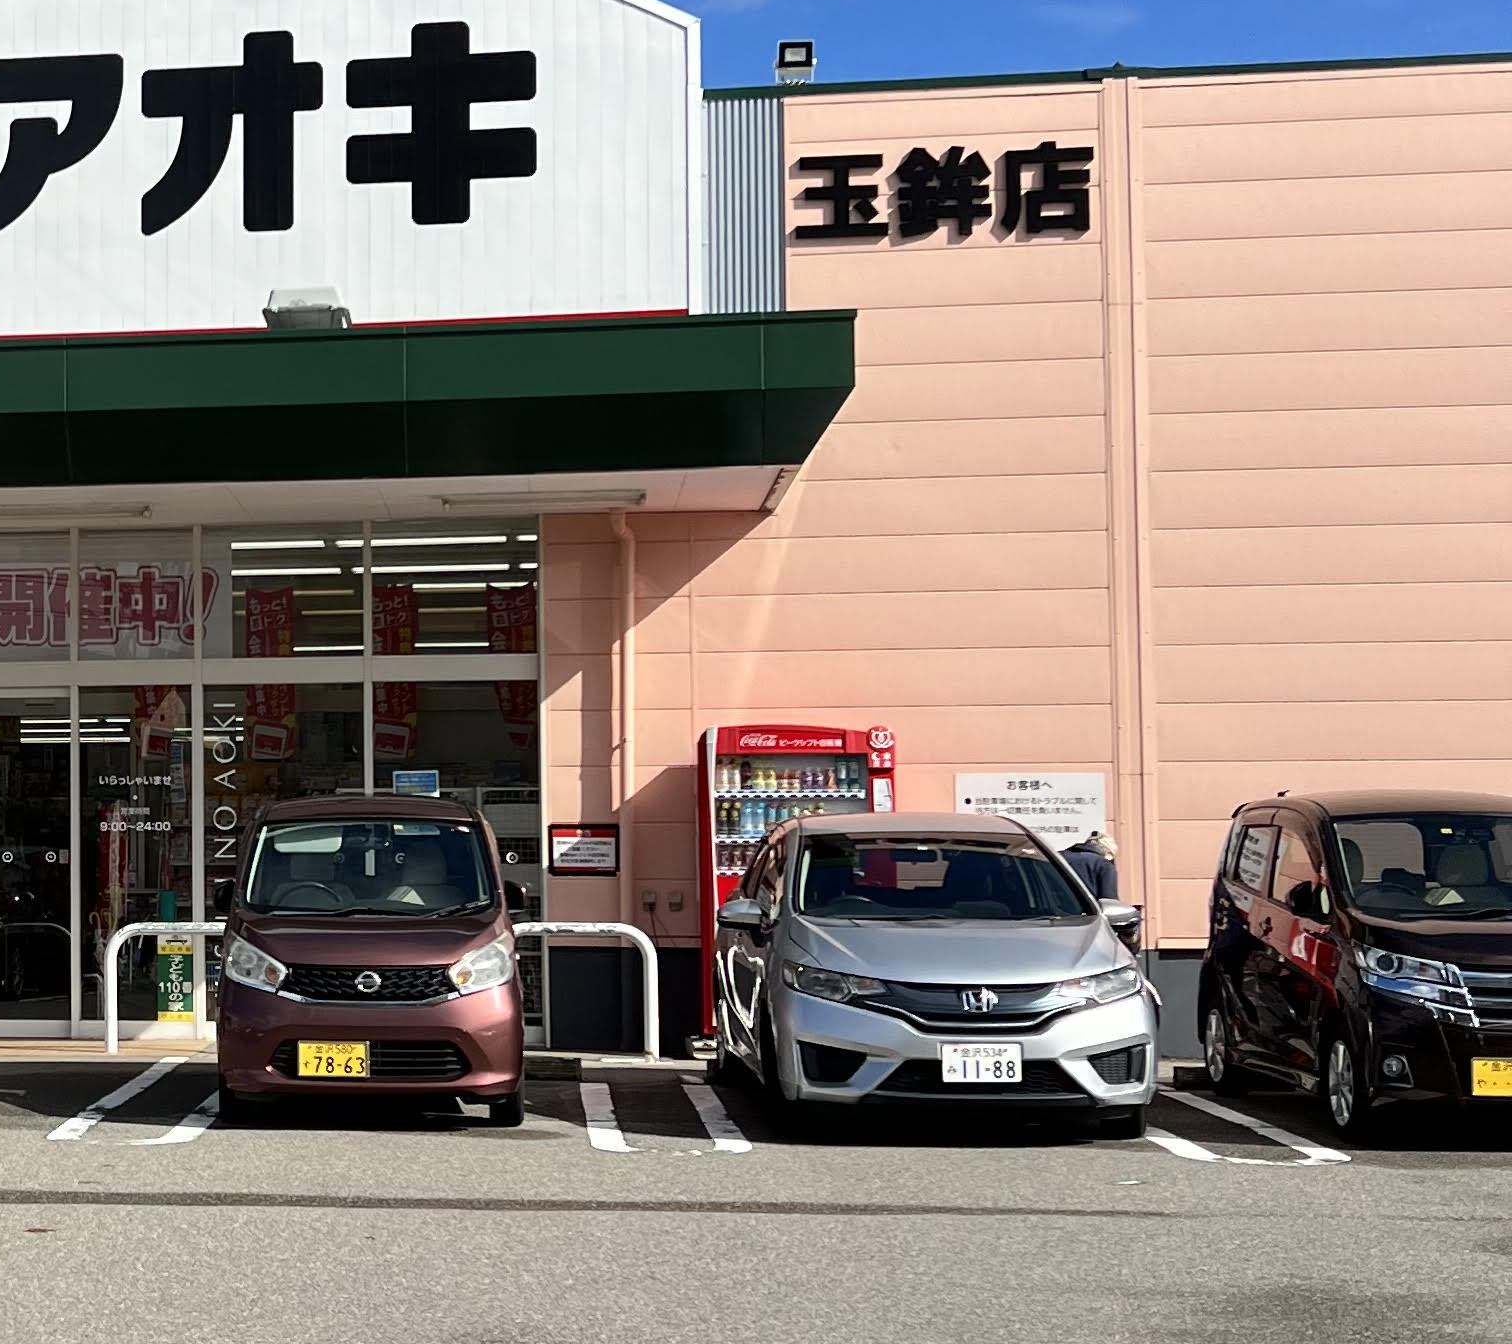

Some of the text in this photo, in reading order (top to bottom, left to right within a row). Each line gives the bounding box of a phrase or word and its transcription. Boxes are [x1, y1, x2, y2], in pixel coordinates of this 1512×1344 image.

[793, 140, 1094, 241] 玉鉾店
[213, 703, 237, 790] AOKI
[98, 775, 172, 786] いらっしゃいませ
[1006, 780, 1052, 790] お客様へ
[213, 806, 238, 859] NO
[313, 1056, 366, 1074] 78-63
[962, 1060, 1016, 1079] 11-88
